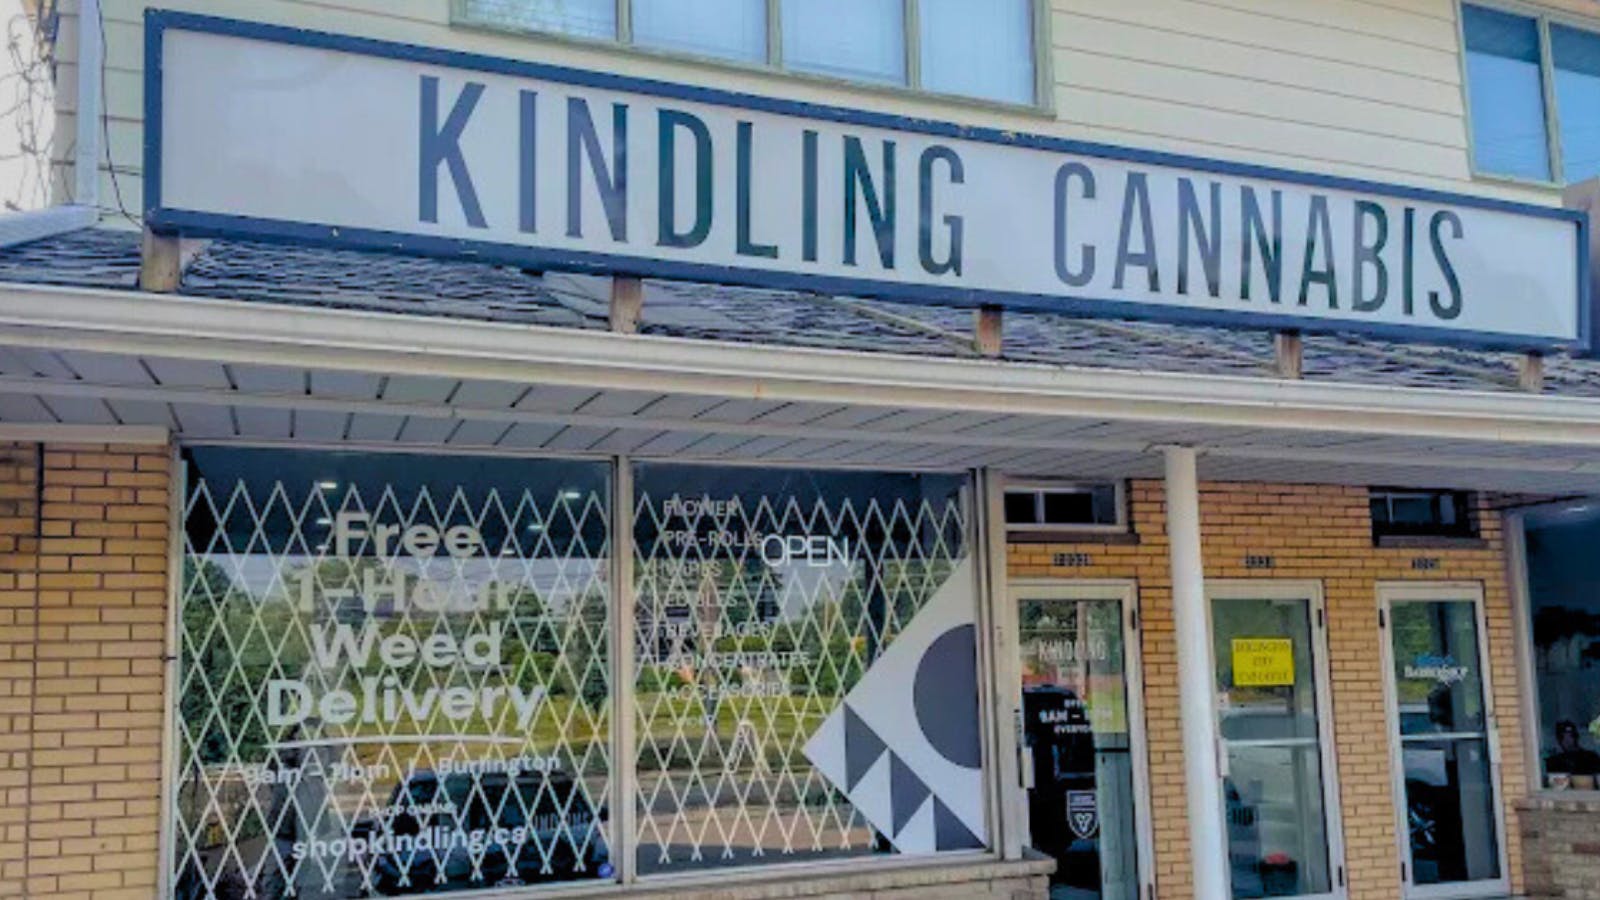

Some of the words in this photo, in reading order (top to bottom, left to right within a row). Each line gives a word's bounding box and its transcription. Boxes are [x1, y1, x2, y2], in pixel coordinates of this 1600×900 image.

[417, 74, 965, 278] KINDLING
[1053, 161, 1464, 321] CANNABIS
[663, 500, 738, 517] FLOWER
[335, 511, 482, 558] Free
[665, 530, 763, 548] PRE-ROLLS
[761, 534, 849, 567] OPEN
[292, 566, 519, 613] 1-Hour
[310, 620, 501, 669] Weed
[266, 675, 546, 731] Delivery
[438, 754, 561, 777] Burlington
[292, 825, 526, 862] shopkindling.ca
